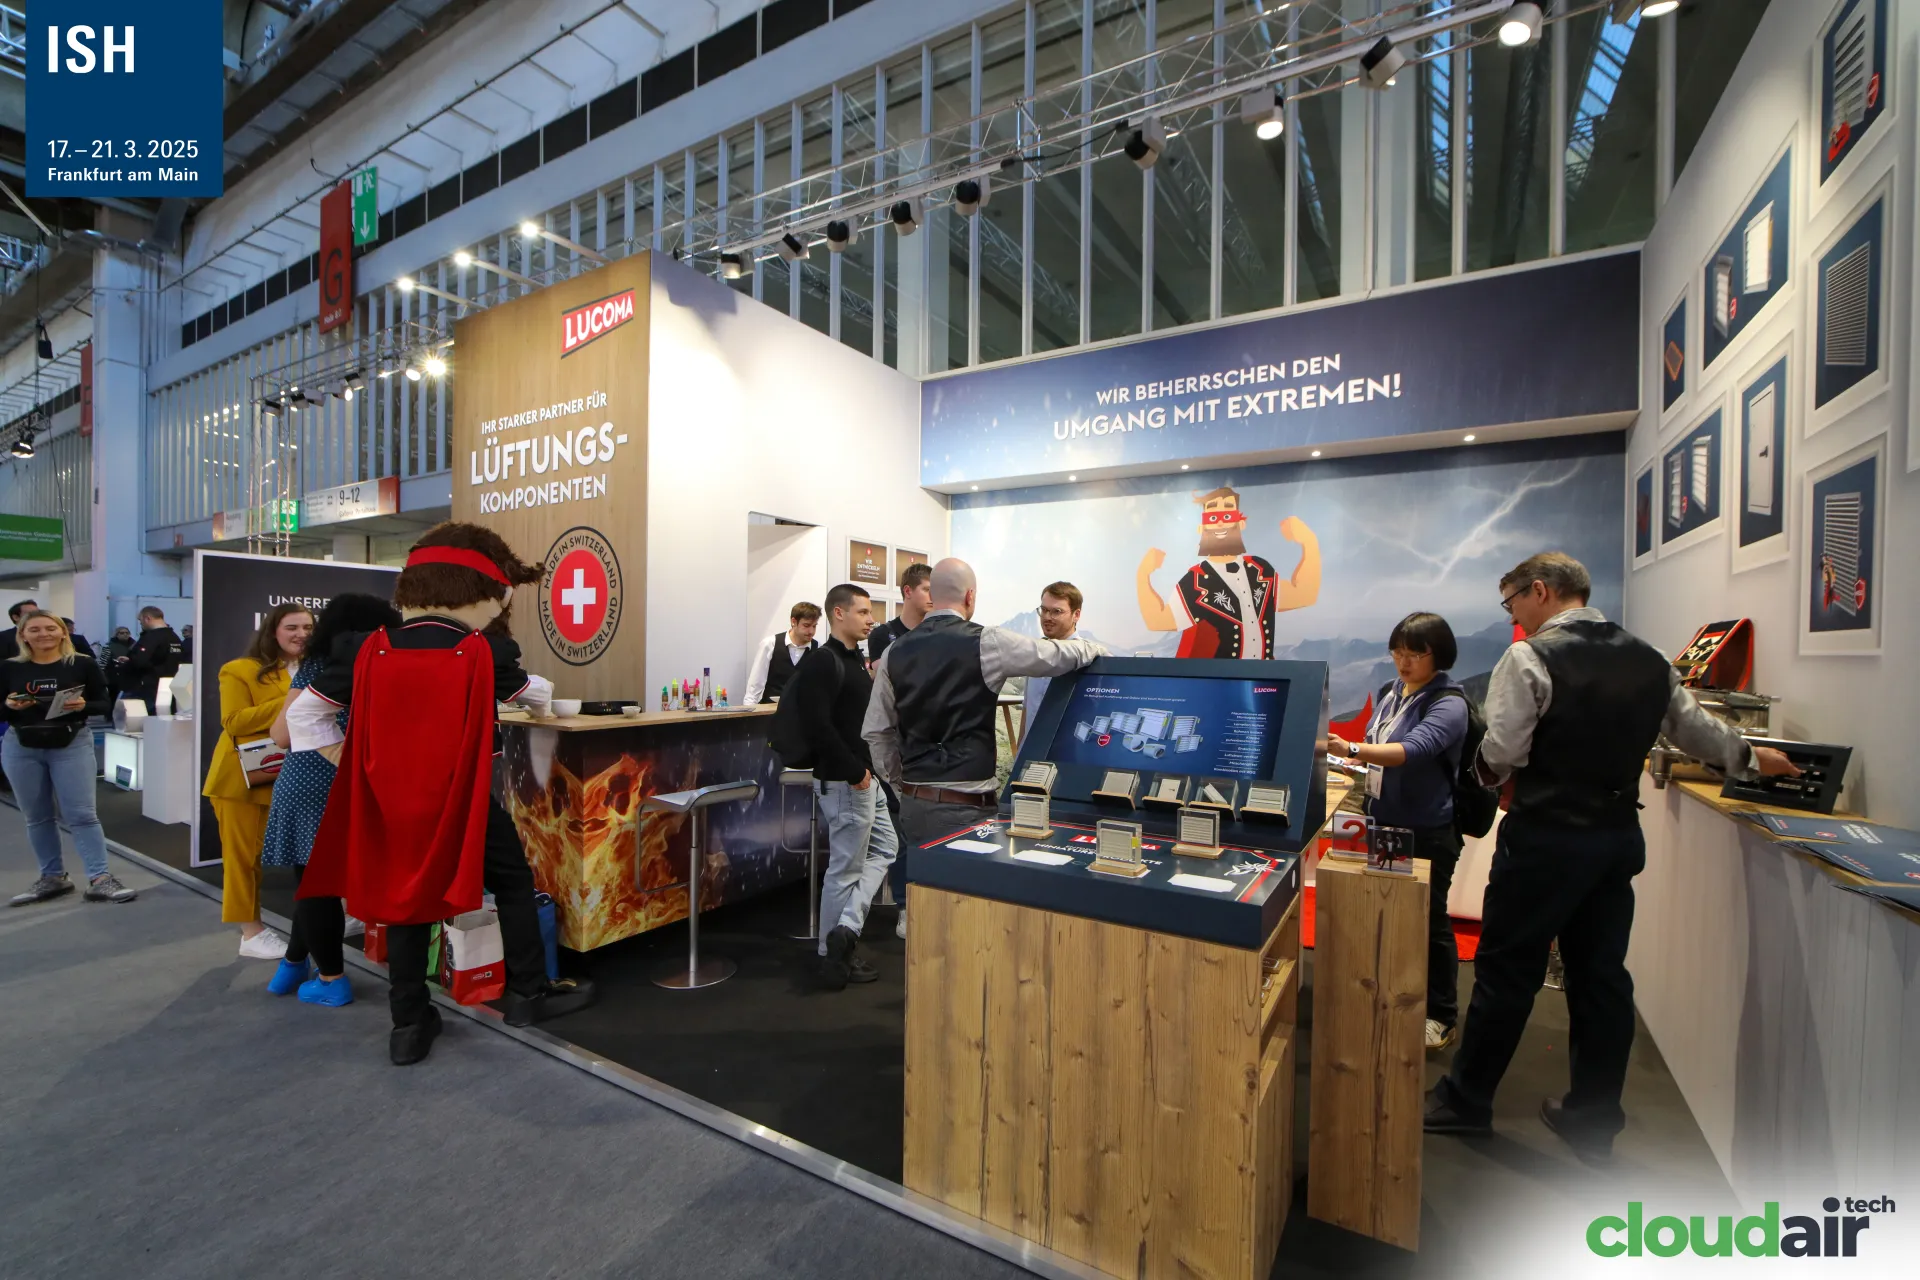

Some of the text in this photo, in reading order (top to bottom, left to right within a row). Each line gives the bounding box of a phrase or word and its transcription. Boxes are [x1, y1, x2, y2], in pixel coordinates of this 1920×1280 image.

[324, 248, 343, 306] G
[565, 295, 633, 349] LUCOMA
[1053, 373, 1402, 441] UMGANG MIT EXTREMEN!
[1096, 353, 1341, 406] WIR BEHERRSCHEN DEN
[481, 390, 608, 435] IHR STARKER PARTNER FÜR
[471, 421, 628, 486] LÜFTUNGS-
[480, 474, 606, 514] KOMPONENTEN
[543, 535, 617, 590] MADE IN SWITZERLAND
[542, 597, 618, 658] MADE IN SWITZERLAND
